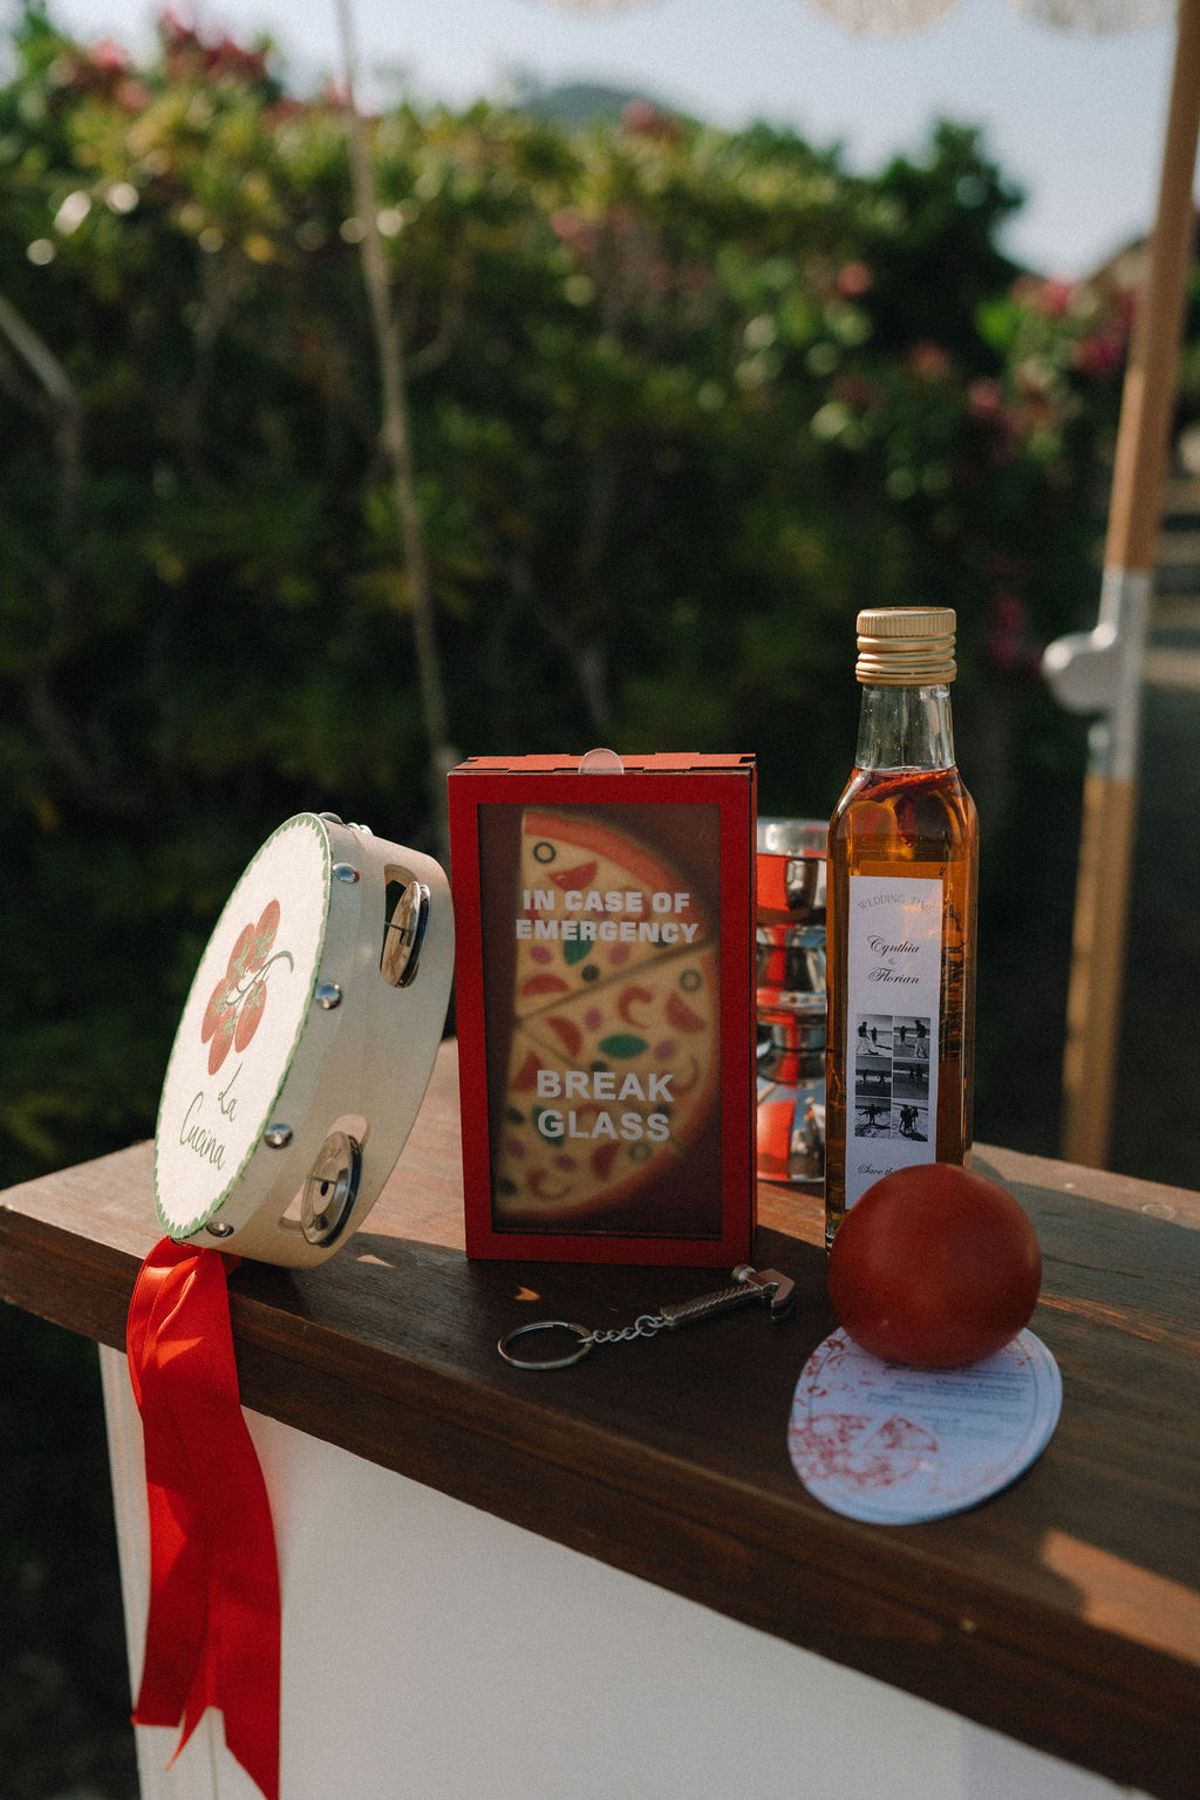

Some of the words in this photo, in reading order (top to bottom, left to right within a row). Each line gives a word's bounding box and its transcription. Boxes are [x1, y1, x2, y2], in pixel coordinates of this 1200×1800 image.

[523, 889, 555, 911] IN
[564, 890, 644, 913] CASE
[652, 892, 691, 913] OF
[515, 918, 700, 944] EMERGENCY
[866, 934, 920, 957] Cynthia
[867, 967, 920, 985] Florian
[218, 1061, 244, 1123] La
[537, 1069, 674, 1102] BREAK
[180, 1091, 226, 1171] Cucina
[537, 1109, 671, 1142] GLASS
